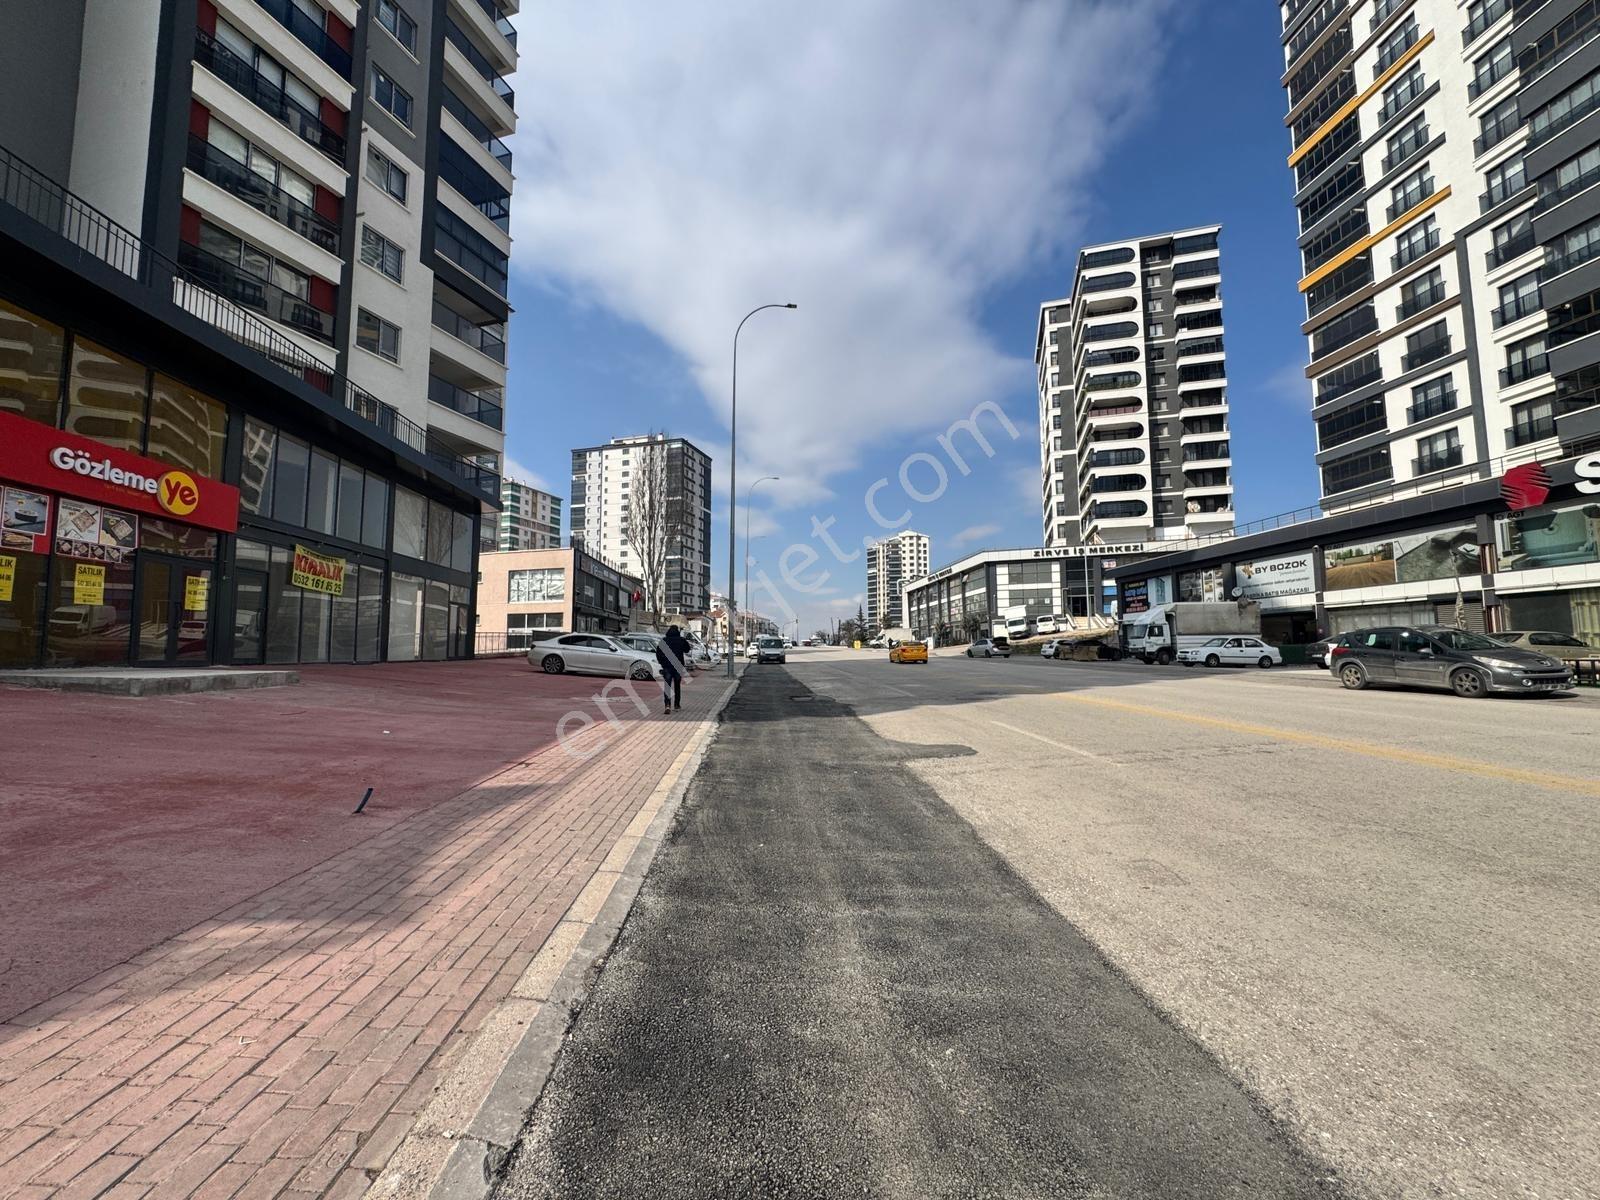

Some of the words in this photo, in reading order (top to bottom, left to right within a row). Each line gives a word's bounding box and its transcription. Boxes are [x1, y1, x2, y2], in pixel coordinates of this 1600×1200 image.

[51, 447, 157, 493] Gözleme
[165, 477, 197, 505] ye
[1507, 511, 1525, 519] AGT
[1033, 547, 1070, 557] ZİRVE
[1074, 547, 1085, 556] İŞ
[1089, 543, 1144, 554] MERKEZİ
[78, 566, 103, 576] SATILIK
[1255, 566, 1268, 574] BY
[1270, 559, 1307, 572] BOZOK
[1280, 587, 1310, 595] MAĞAZASI
